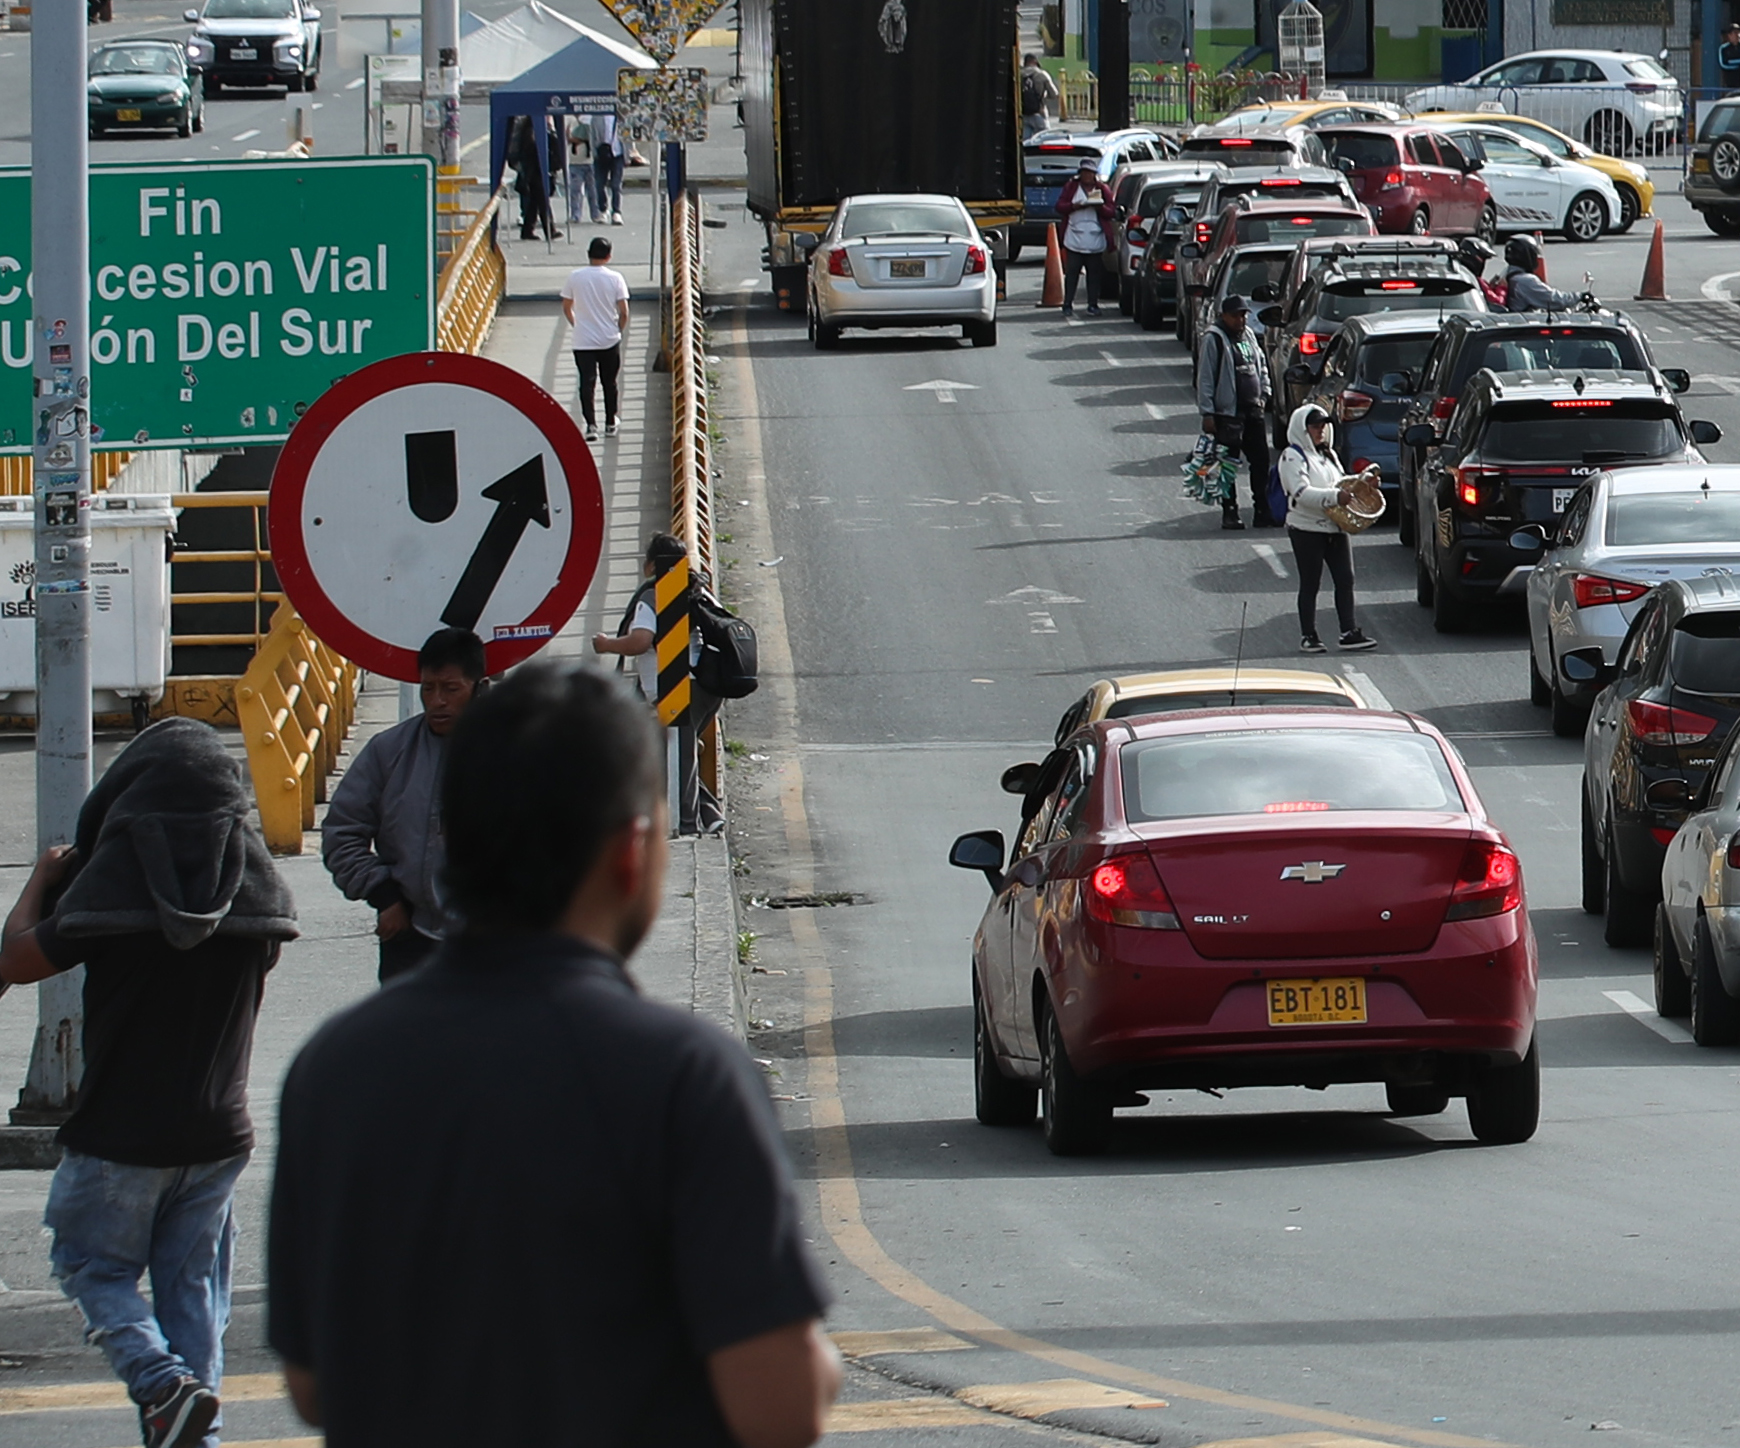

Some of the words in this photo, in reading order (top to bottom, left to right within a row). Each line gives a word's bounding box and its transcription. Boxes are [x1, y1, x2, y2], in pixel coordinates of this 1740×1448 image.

[140, 182, 222, 237] Fin
[0, 251, 273, 305] Ccesion
[290, 244, 388, 294] Vial
[2, 315, 156, 368] Uón
[178, 311, 260, 362] Del
[280, 308, 373, 358] Sur
[1194, 914, 1228, 925] SAIL
